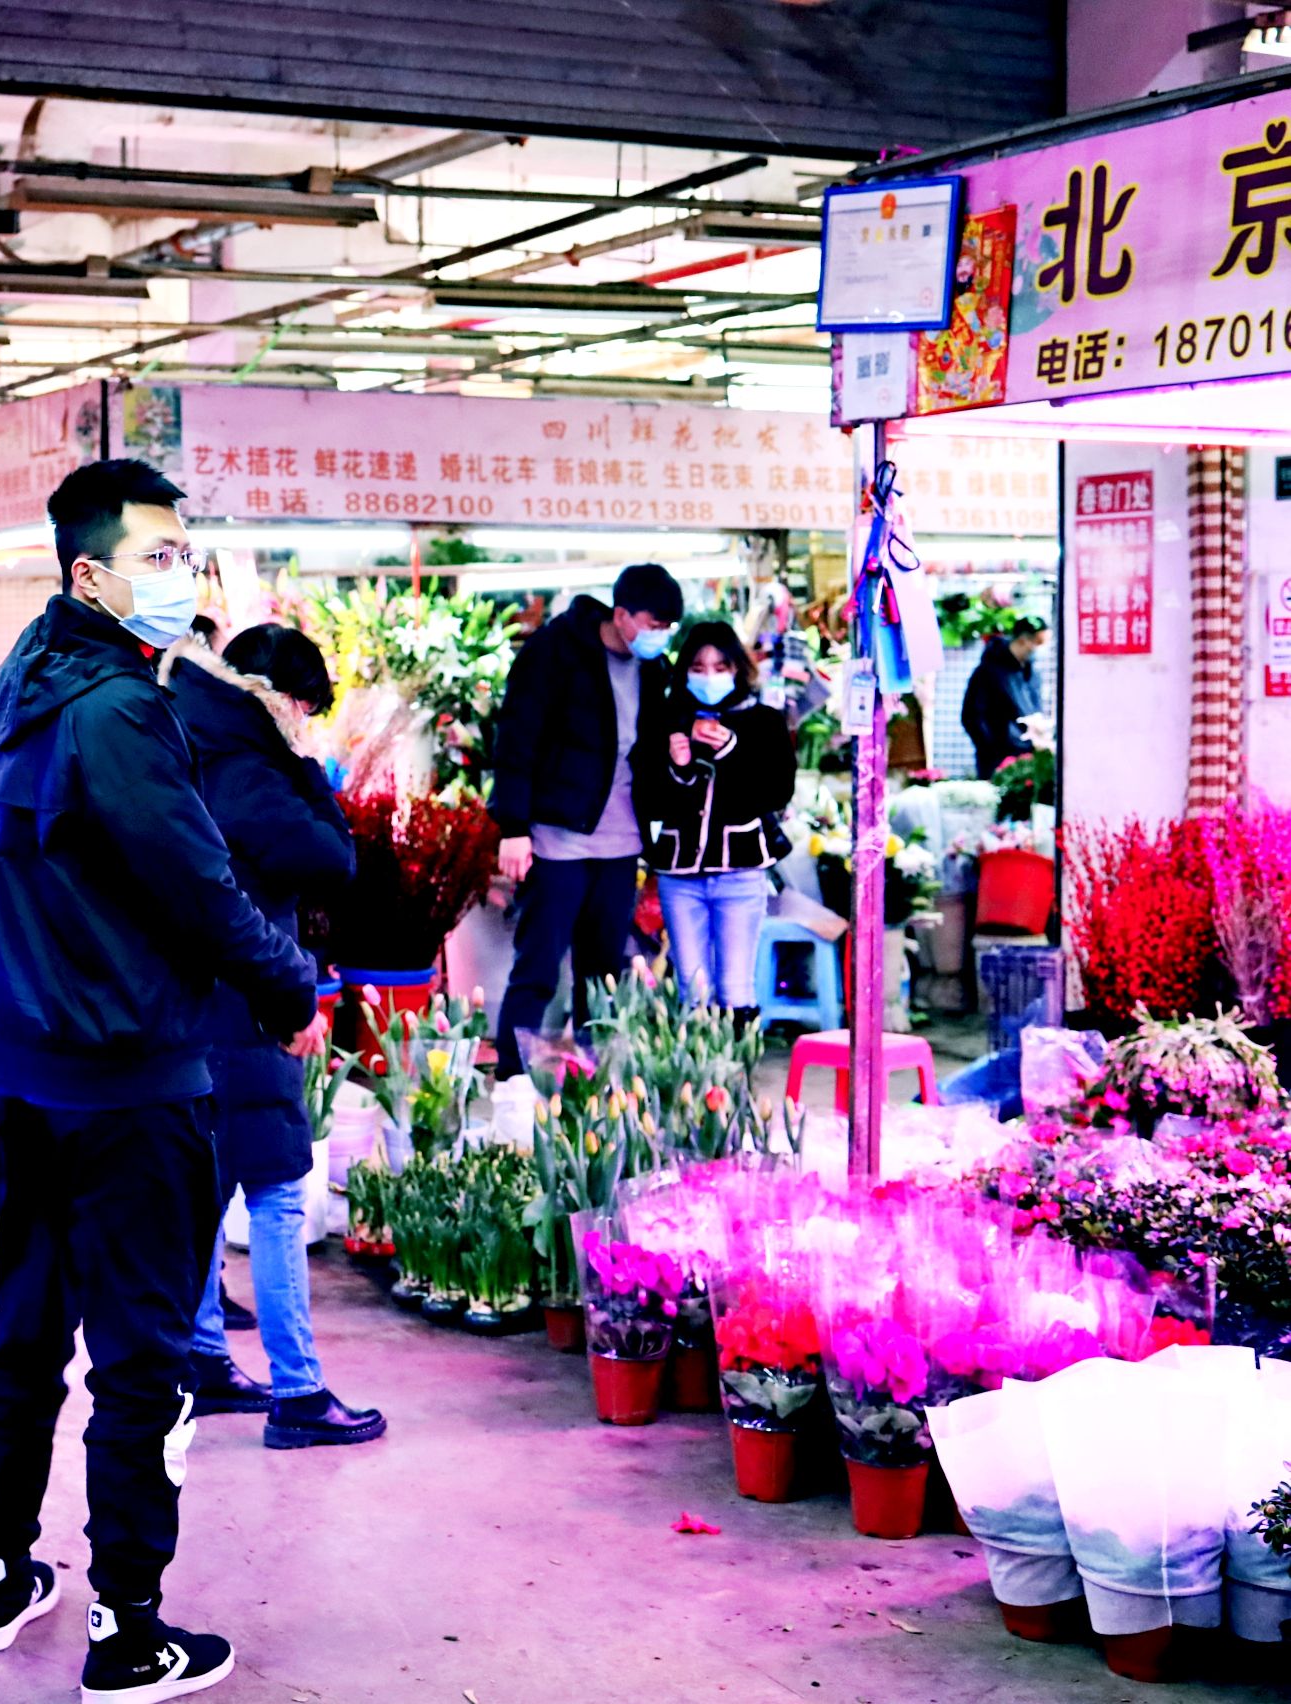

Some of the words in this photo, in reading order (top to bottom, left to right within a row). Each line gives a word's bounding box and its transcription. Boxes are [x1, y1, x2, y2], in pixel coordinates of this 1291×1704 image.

[1036, 120, 1291, 303] 北京
[192, 446, 299, 478] 艺术插花
[313, 448, 418, 481] 鲜花速递
[439, 452, 538, 484] 婚礼花车
[344, 492, 494, 516] 88682100
[522, 498, 715, 521] 13041021388
